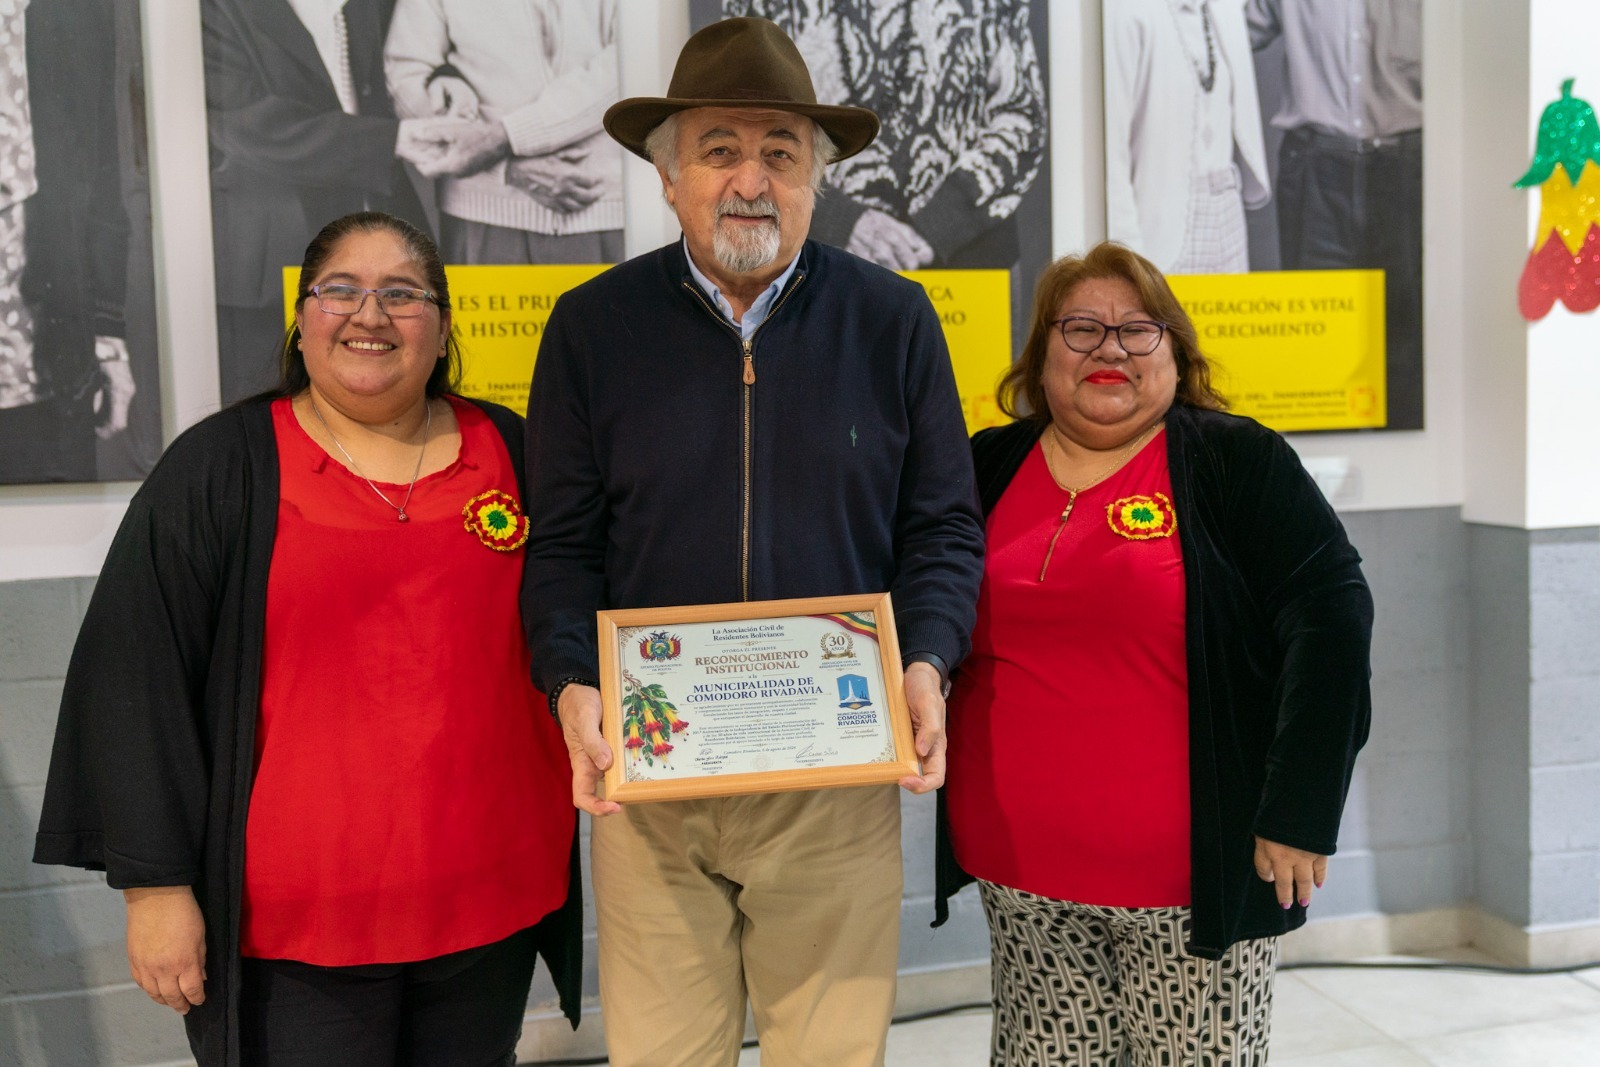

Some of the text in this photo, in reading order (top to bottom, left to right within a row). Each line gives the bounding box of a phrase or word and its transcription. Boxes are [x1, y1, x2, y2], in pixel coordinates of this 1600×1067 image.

[458, 295, 560, 311] ES EL PRI
[1182, 297, 1355, 316] TEGRACIÓN ES VITAL
[1204, 322, 1327, 338] CRECIMIENTO
[722, 626, 758, 634] Asociación
[750, 631, 785, 639] Bolivianos
[829, 636, 845, 646] 30
[694, 650, 809, 666] RECONOCIMIENTO
[705, 661, 800, 675] INSTITUCIONAL
[693, 677, 814, 693] MUNICIPALIDAD DE
[686, 686, 823, 703] COMODORO RIVADAVIA
